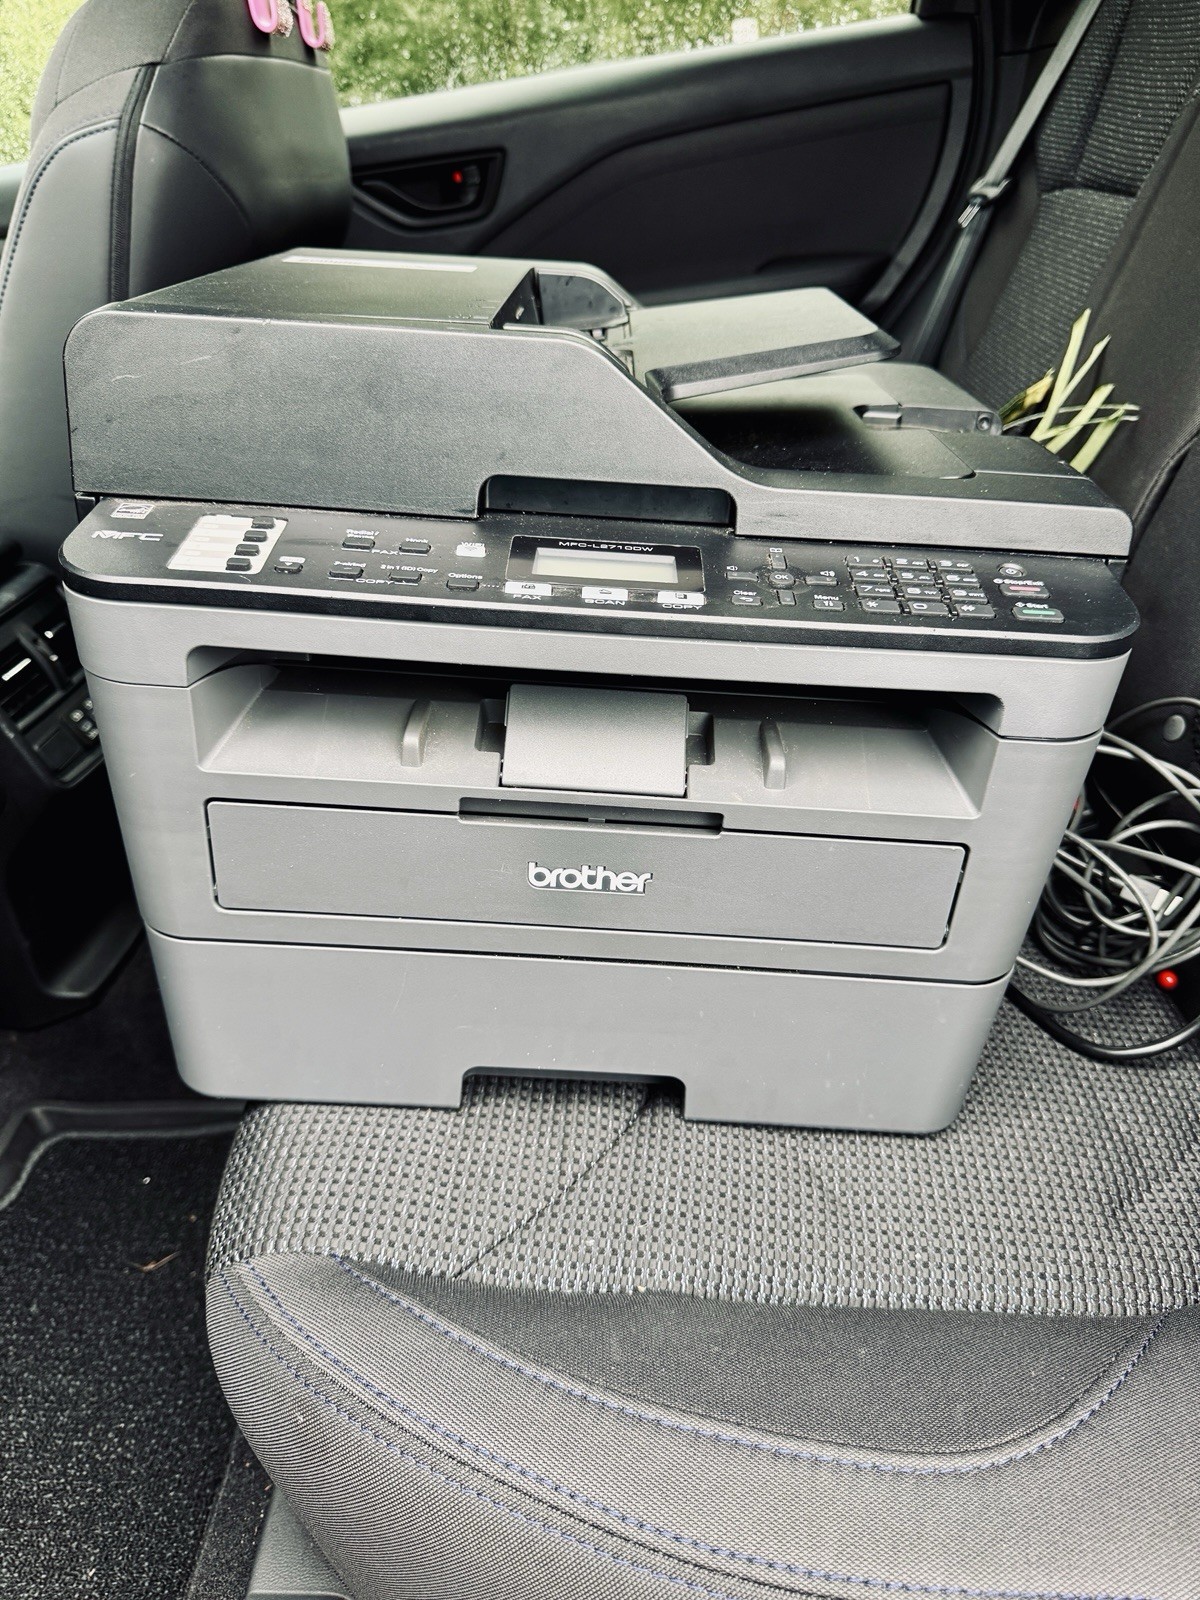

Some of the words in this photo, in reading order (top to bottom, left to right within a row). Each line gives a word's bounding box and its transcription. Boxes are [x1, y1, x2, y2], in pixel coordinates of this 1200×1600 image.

[91, 529, 164, 542] MFC
[558, 541, 654, 552] MFC-L2710DW
[416, 566, 439, 574] Copy
[448, 572, 483, 580] Options
[513, 593, 542, 601] FAX
[584, 598, 626, 606] SCAN
[912, 602, 928, 610] 0
[527, 861, 653, 893] brother
